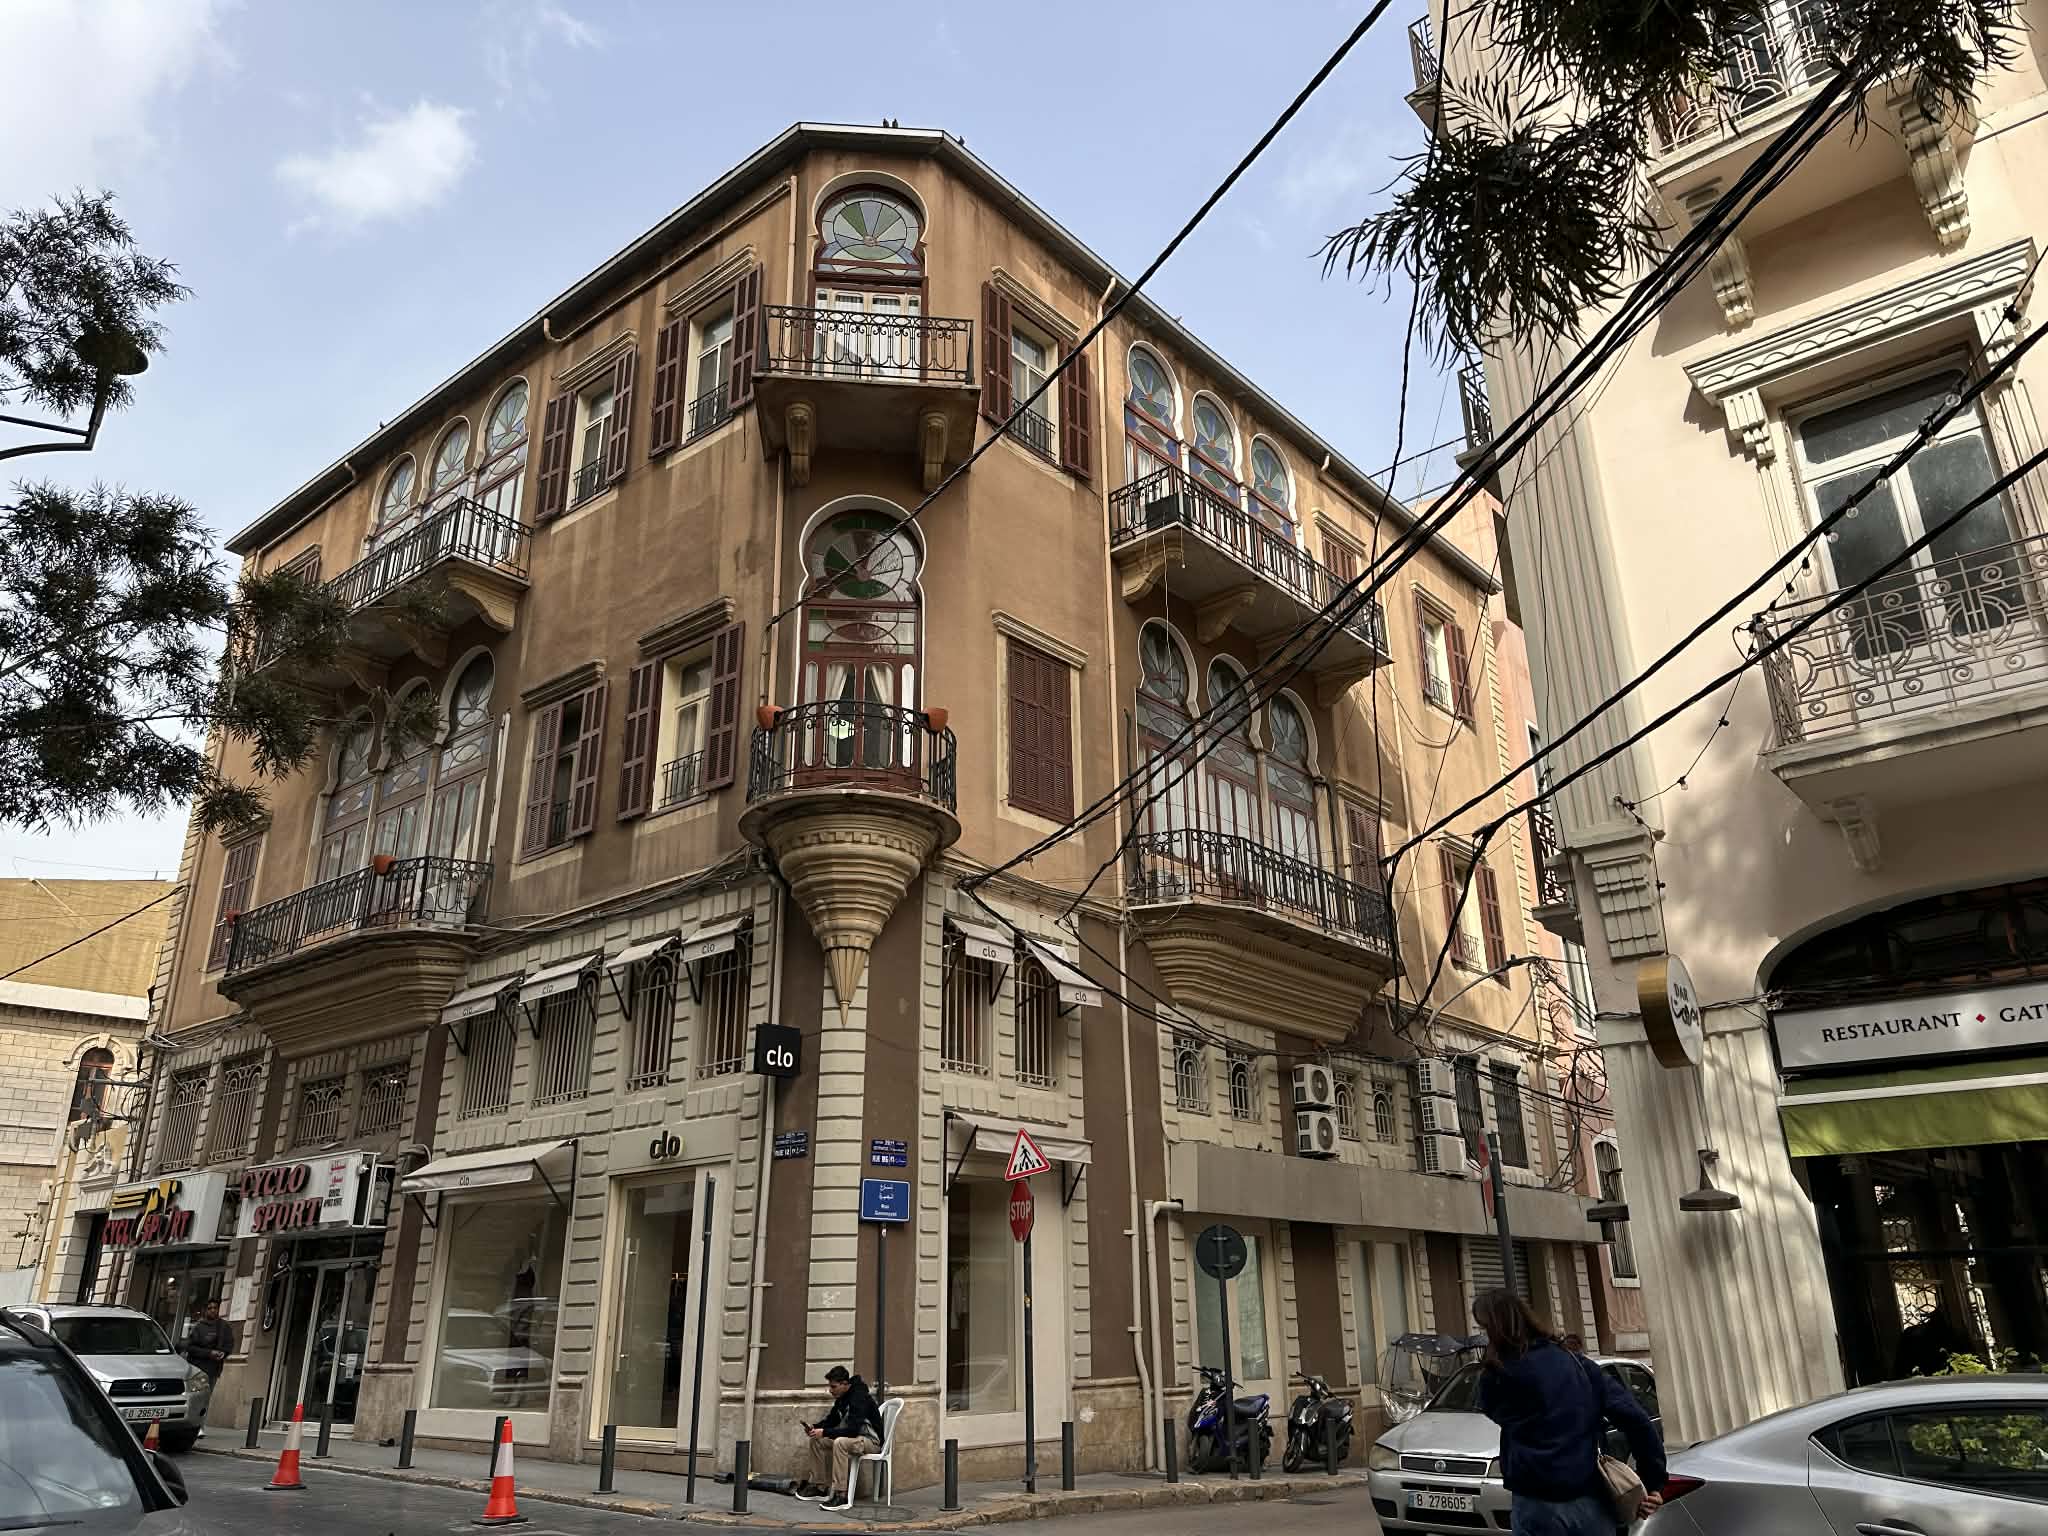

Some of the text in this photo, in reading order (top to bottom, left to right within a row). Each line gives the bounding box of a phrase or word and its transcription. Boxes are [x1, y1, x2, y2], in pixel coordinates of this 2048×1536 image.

[982, 946, 997, 957] clo
[1075, 991, 1087, 1002] clo
[1821, 1004, 2048, 1043] RESTAURANT GAT
[766, 1044, 793, 1067] clo
[650, 1130, 681, 1159] clo
[240, 1163, 308, 1198] CYCLO
[251, 1196, 323, 1233] SPORT
[1010, 1200, 1031, 1221] STOP
[1429, 1494, 1466, 1510] 278605
